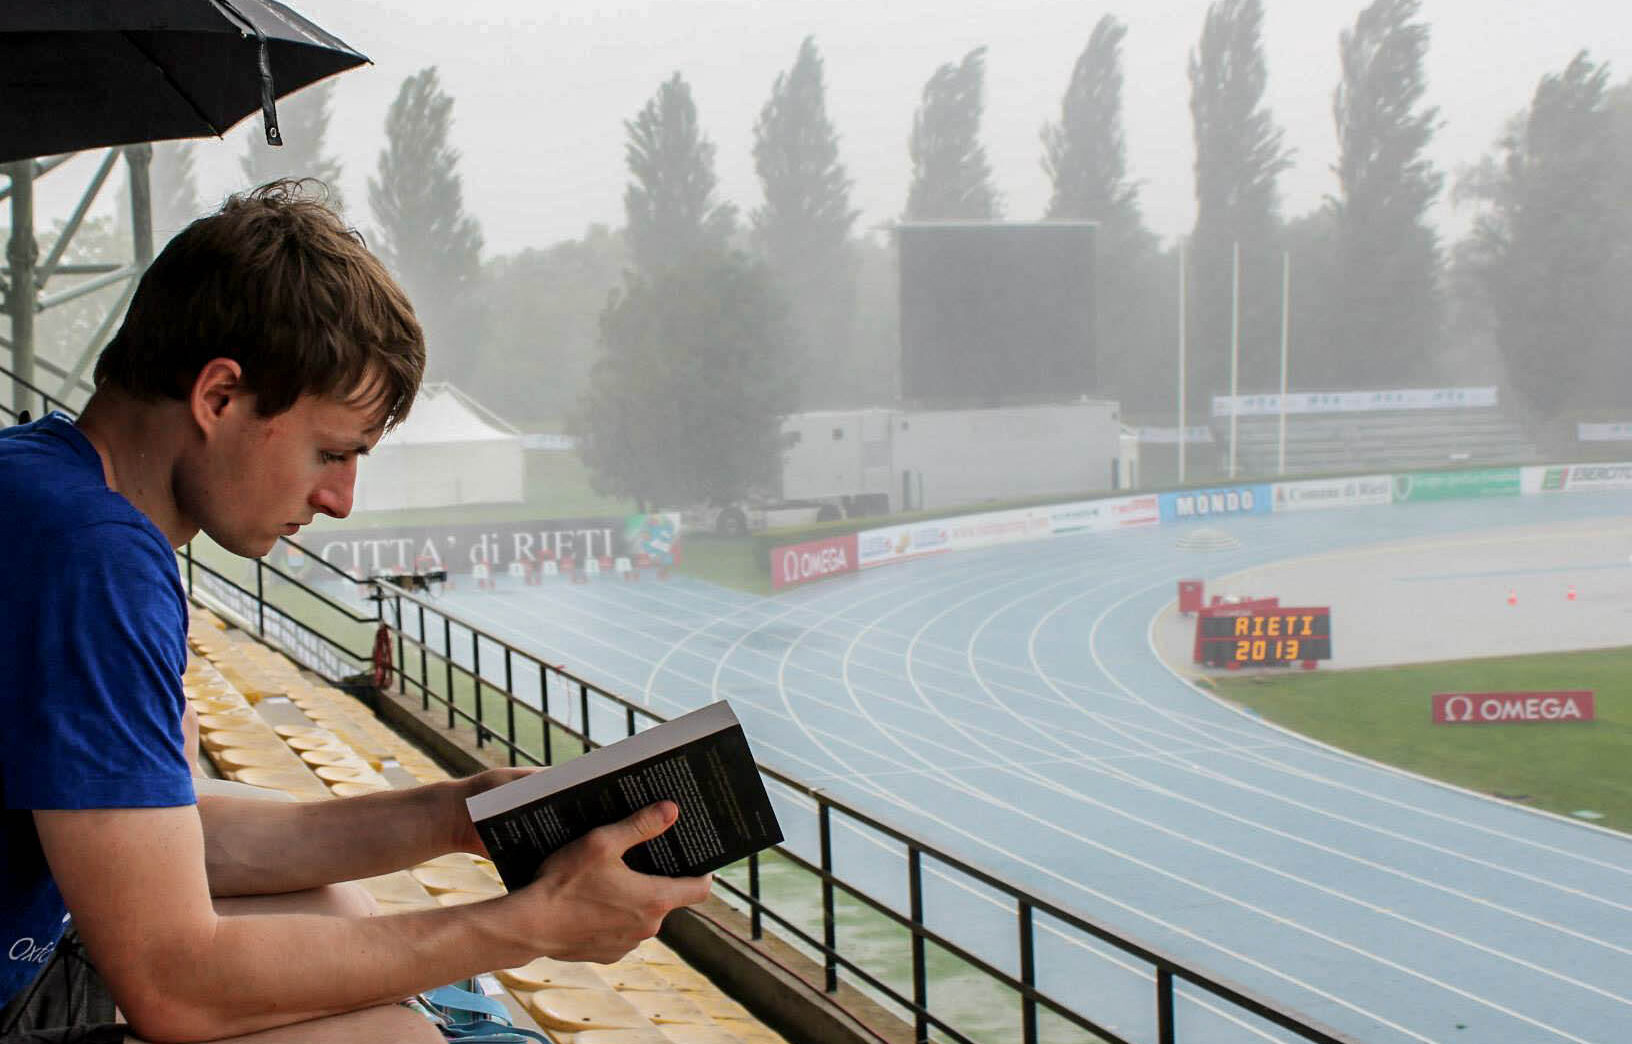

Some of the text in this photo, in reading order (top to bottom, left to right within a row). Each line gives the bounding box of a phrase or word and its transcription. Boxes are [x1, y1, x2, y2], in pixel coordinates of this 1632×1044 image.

[1175, 490, 1254, 517] MONDO
[470, 533, 499, 565] di
[513, 528, 615, 561] RIETI
[799, 547, 848, 577] OMEGA
[1235, 616, 1314, 636] RIETI
[1235, 640, 1299, 661] 2013
[1480, 697, 1581, 721] OMEGA
